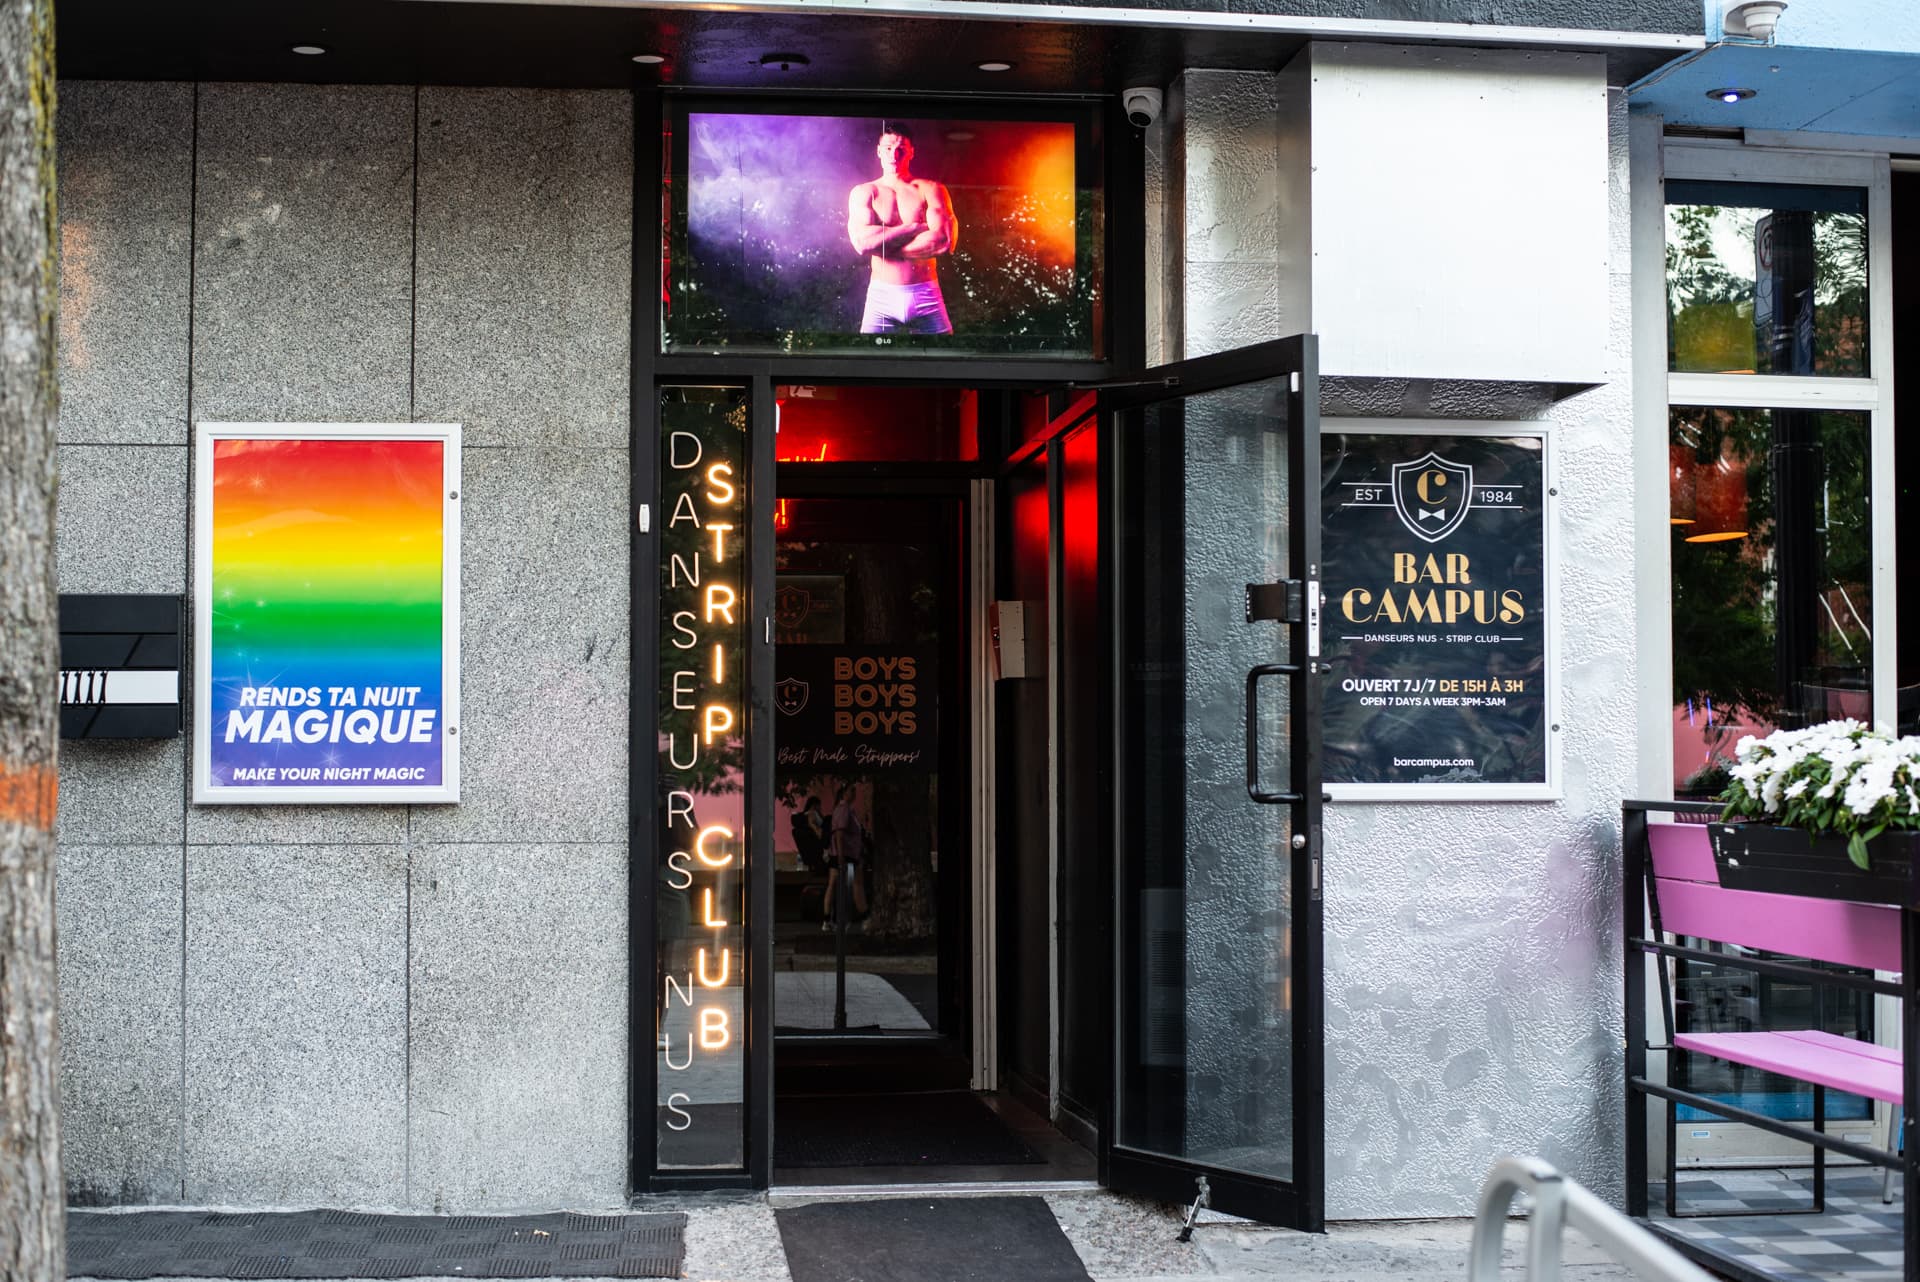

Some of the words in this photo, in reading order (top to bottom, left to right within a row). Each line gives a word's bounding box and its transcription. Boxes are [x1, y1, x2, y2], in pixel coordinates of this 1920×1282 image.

[1355, 489, 1383, 500] EST
[1480, 491, 1513, 503] 1984
[1416, 469, 1447, 505] C
[1393, 552, 1472, 585] BAR
[705, 462, 735, 745] STRIP
[1341, 587, 1525, 625] CAMPUS
[1364, 634, 1415, 643] DANSEURS
[1417, 634, 1437, 643] NUS
[1446, 635, 1472, 643] STRIP
[1475, 635, 1500, 643] CLUB
[667, 431, 702, 889] DANSEURS
[834, 656, 918, 681] BOYS
[239, 687, 322, 707] RENDS
[328, 687, 357, 707] TA
[363, 687, 421, 707] NUIT
[834, 683, 918, 708] BOYS
[1342, 679, 1400, 692] OUVERT
[1403, 678, 1436, 693] 7J/7
[1439, 679, 1459, 692] DE
[1462, 679, 1487, 692] 15H
[1490, 677, 1501, 692] À
[1504, 680, 1523, 692] 3H
[1360, 697, 1386, 706] OPEN
[1388, 697, 1394, 706] 7
[1395, 697, 1421, 706] DAYS
[1423, 697, 1431, 706] A
[1432, 697, 1459, 706] WEEK
[1460, 697, 1506, 706] 3PM-3AM
[224, 709, 436, 744] MAGIQUE
[834, 710, 918, 735] BOYS
[777, 746, 809, 766] Best
[812, 746, 848, 765] Male
[1393, 757, 1474, 768] barcampus.com
[233, 768, 275, 780] MAKE
[280, 768, 320, 780] YOUR
[323, 768, 371, 780] NIGHT
[373, 768, 425, 780] MAGIC
[697, 825, 734, 1049] CLUB
[665, 972, 693, 1132] NUS
